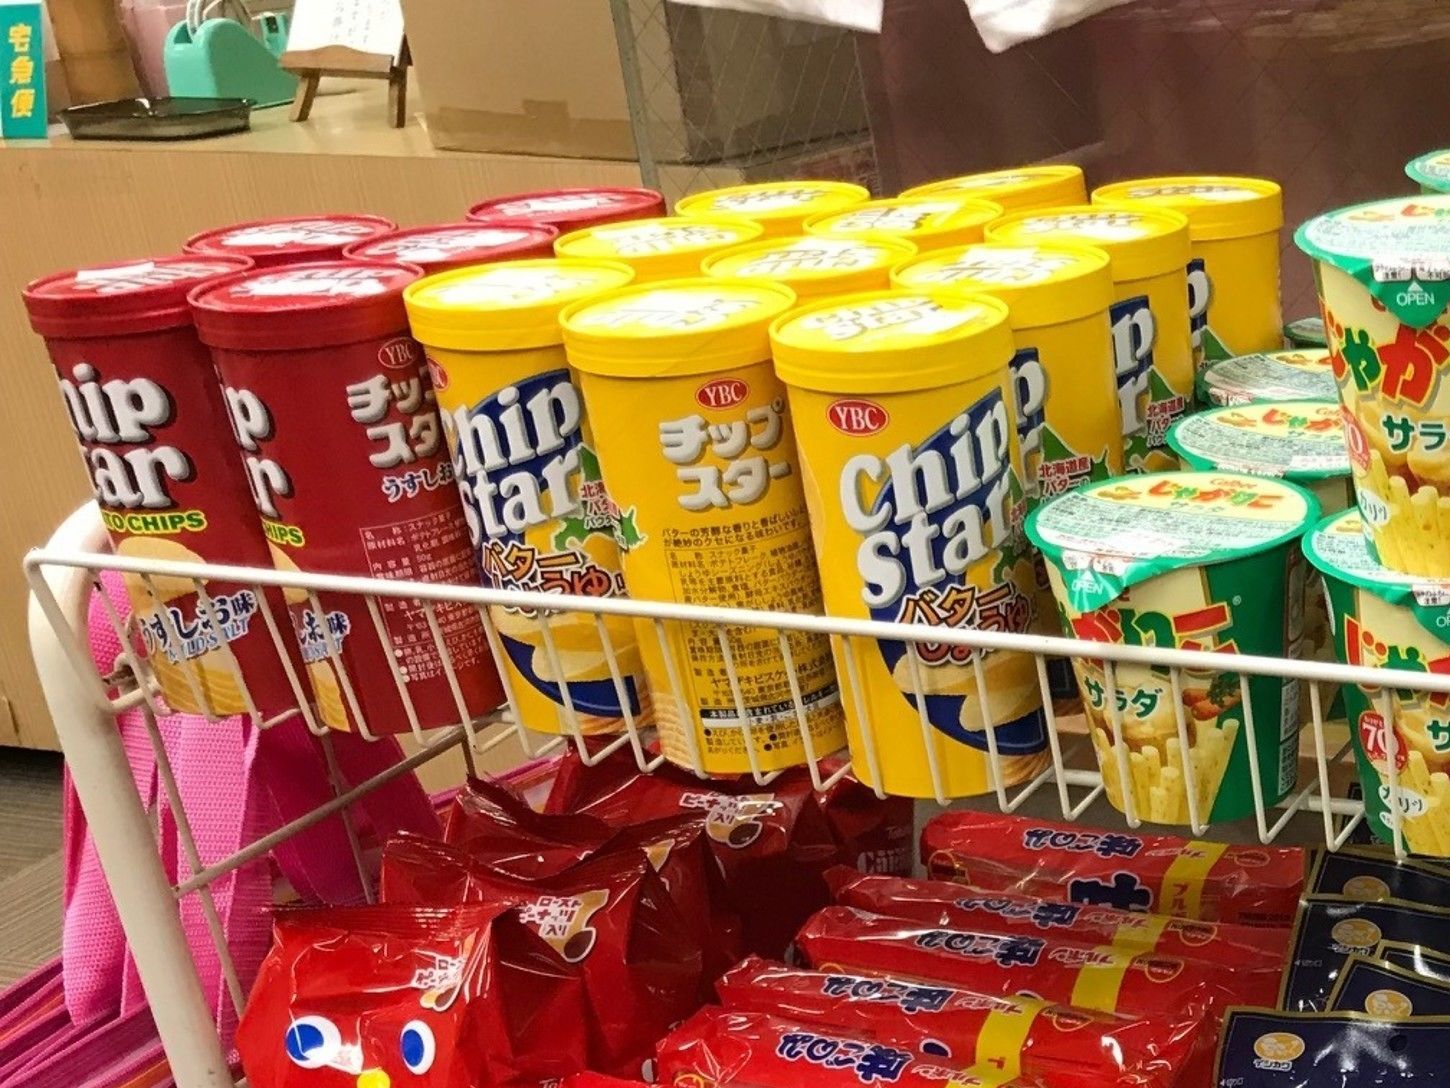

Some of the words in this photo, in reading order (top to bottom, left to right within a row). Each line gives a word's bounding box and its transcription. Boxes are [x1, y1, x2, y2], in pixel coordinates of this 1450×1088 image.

[9, 23, 34, 119] 宅急便
[1396, 293, 1436, 306] OPEN
[705, 385, 741, 407] YBC
[659, 395, 784, 465] チップ
[836, 405, 878, 431] YBC
[677, 456, 792, 512] スター
[840, 398, 1009, 533] Chip
[1038, 456, 1091, 477] 北海道産
[131, 510, 205, 531] CHIPS
[857, 478, 1012, 608] Star
[913, 929, 1047, 967] 味ごのみ
[819, 974, 953, 1014] 味ごのみ
[774, 1031, 913, 1085] 味ごのみ
